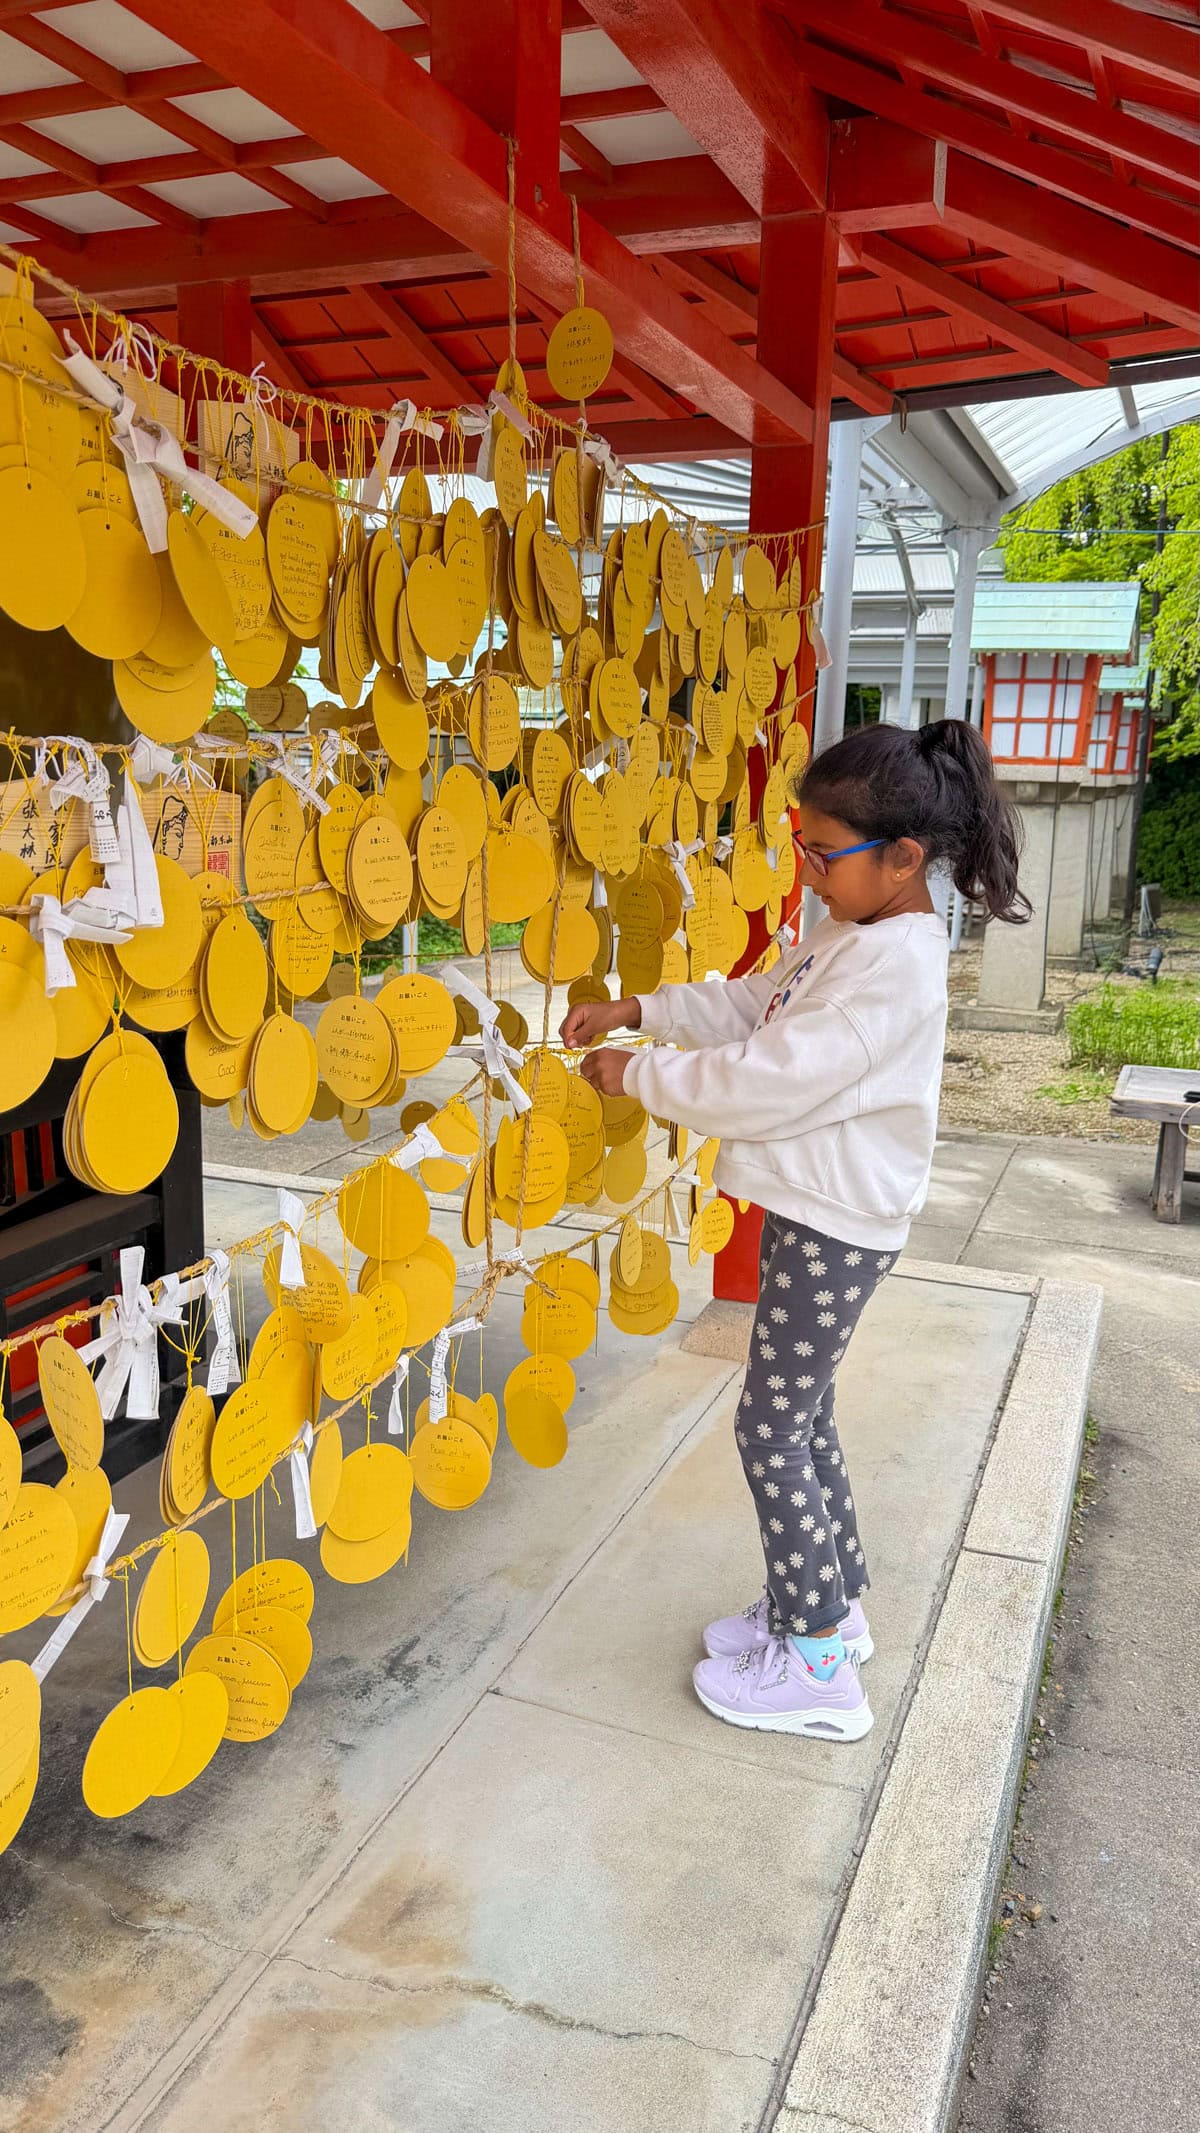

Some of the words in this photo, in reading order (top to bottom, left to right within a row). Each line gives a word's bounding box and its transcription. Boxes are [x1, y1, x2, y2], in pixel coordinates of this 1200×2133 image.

[217, 1655, 252, 1667] お願いごと
